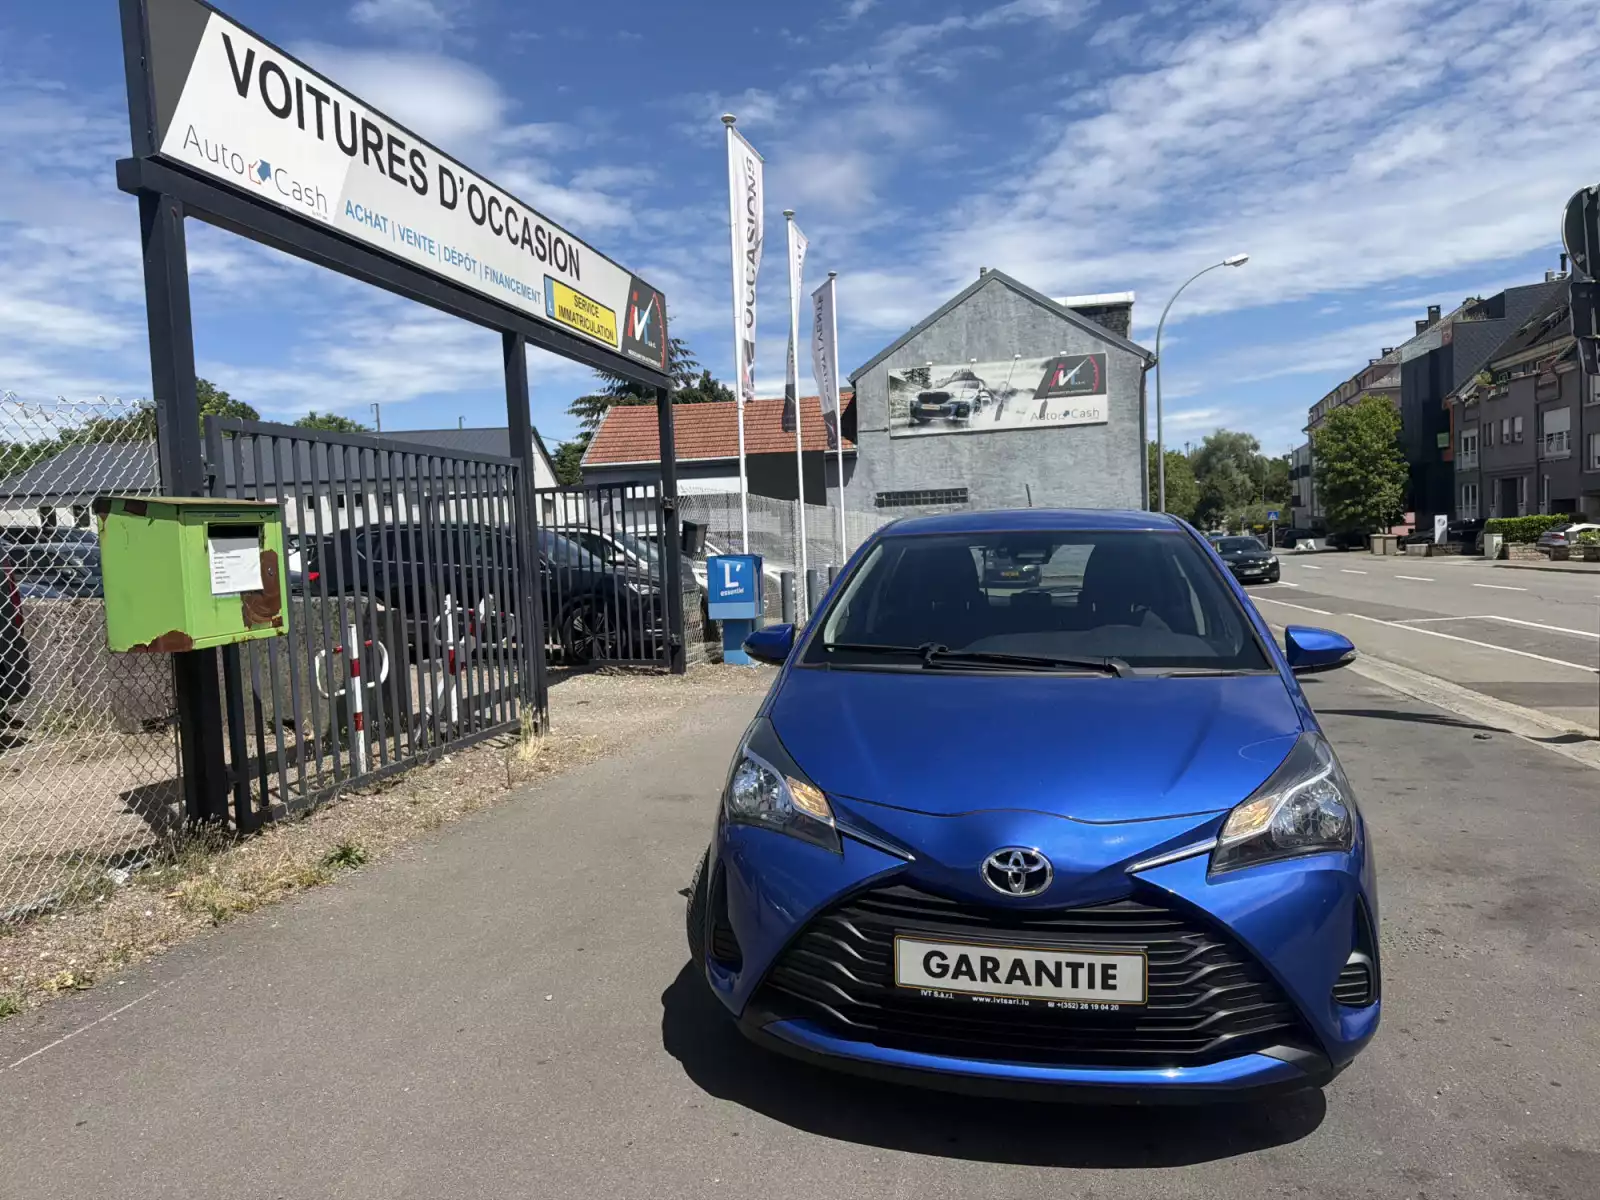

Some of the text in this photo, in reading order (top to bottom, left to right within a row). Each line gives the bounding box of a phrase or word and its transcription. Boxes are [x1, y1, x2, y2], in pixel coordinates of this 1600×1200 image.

[183, 124, 328, 213] Auto Cash
[221, 31, 580, 281] VOITURES D'OCCASION
[345, 199, 541, 304] ACHAT VENTE DÉPÔT FINANCEMENT
[558, 304, 614, 341] IMMATRICULATION
[573, 294, 600, 318] SERVICE
[1071, 407, 1100, 420] Cash
[922, 950, 1118, 991] GARANTIE
[972, 996, 1030, 1006] www.ivtsarl.lu
[1056, 1001, 1079, 1010] +(352)
